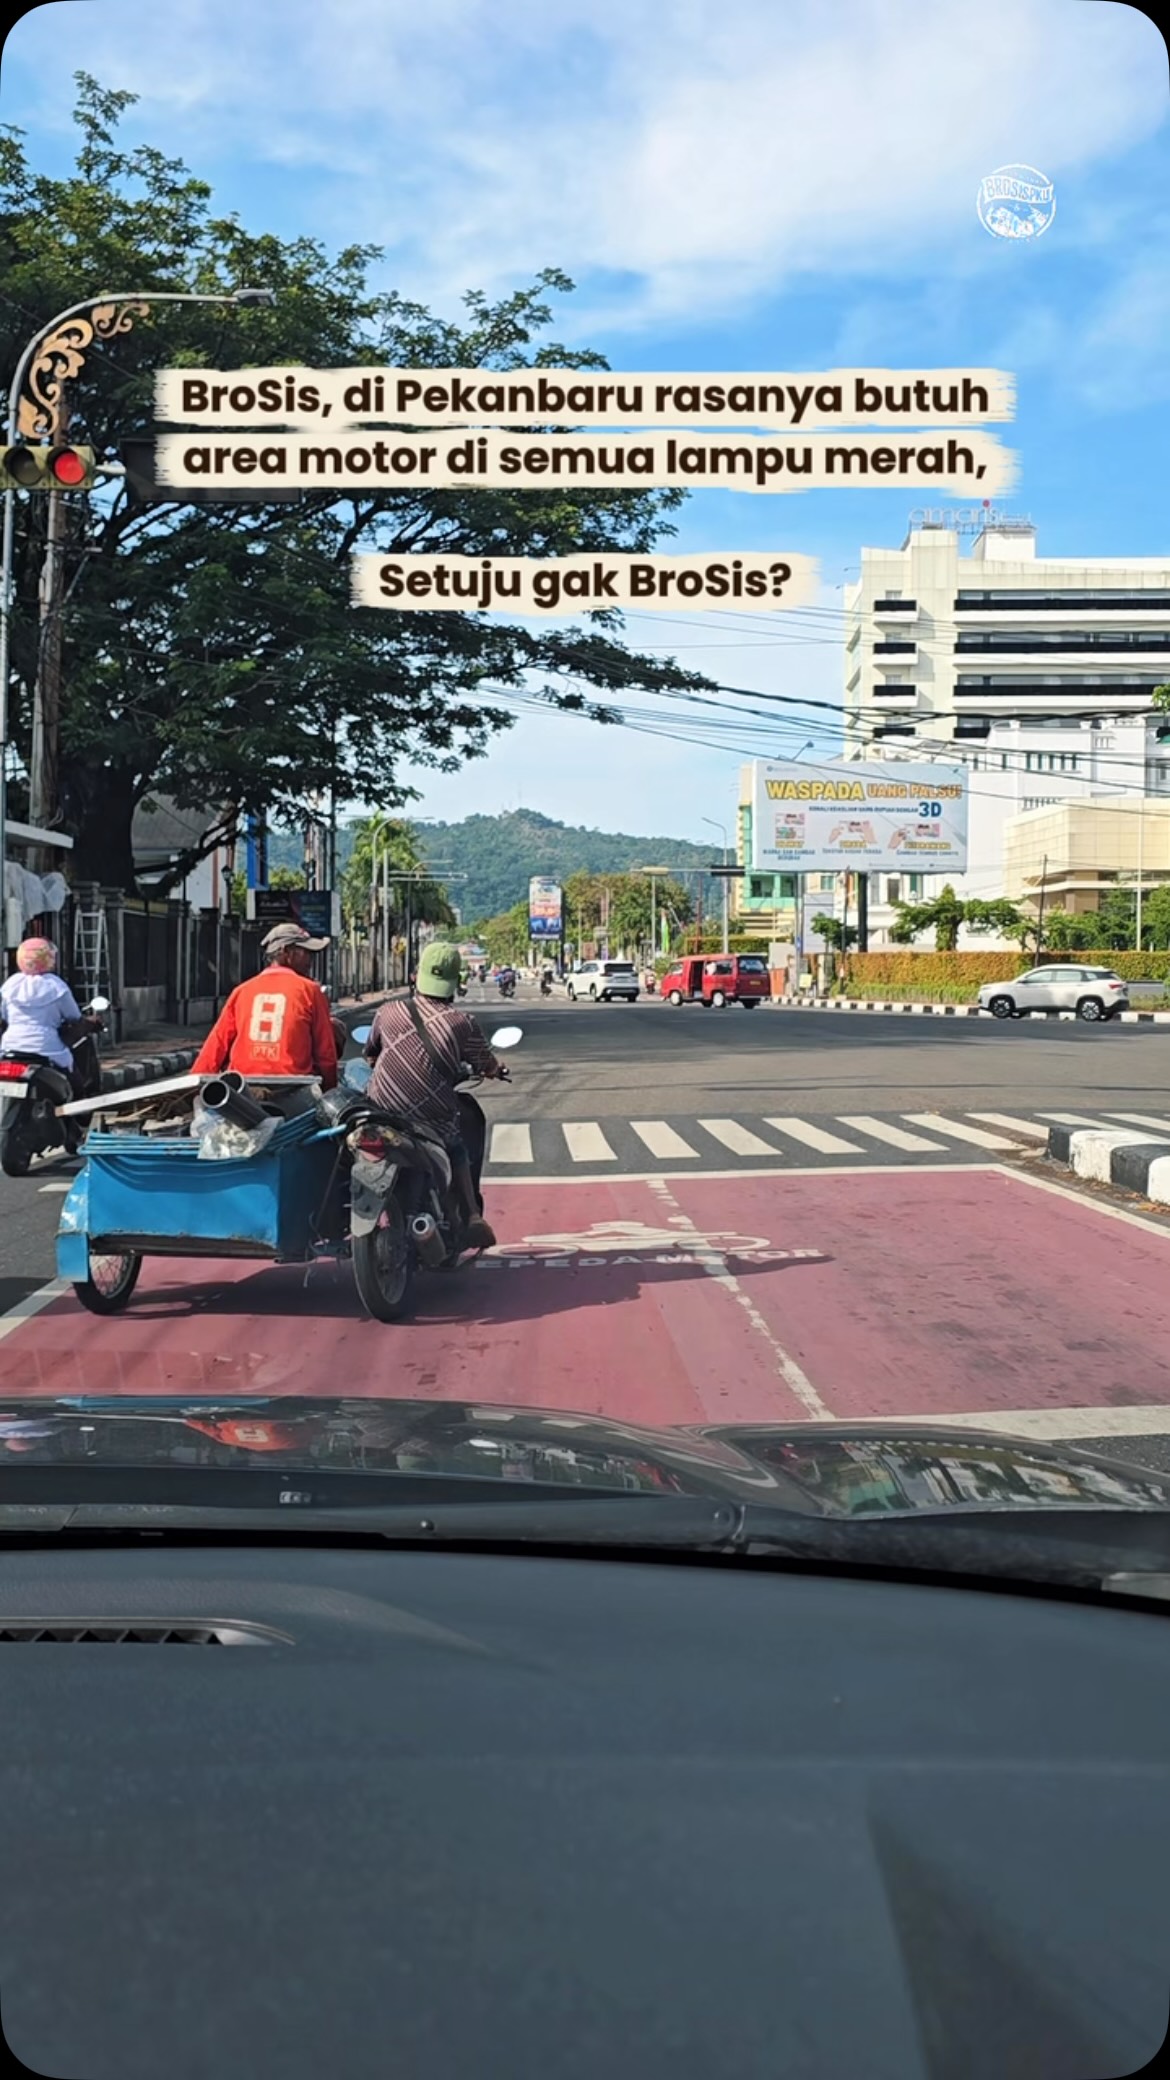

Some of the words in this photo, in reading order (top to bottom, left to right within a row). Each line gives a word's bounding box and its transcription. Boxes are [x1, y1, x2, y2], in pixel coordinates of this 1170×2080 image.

[766, 780, 865, 800] WASPADA
[867, 783, 907, 799] UANG
[919, 802, 942, 817] 3D
[249, 992, 287, 1042] 8
[253, 1046, 277, 1058] PTK
